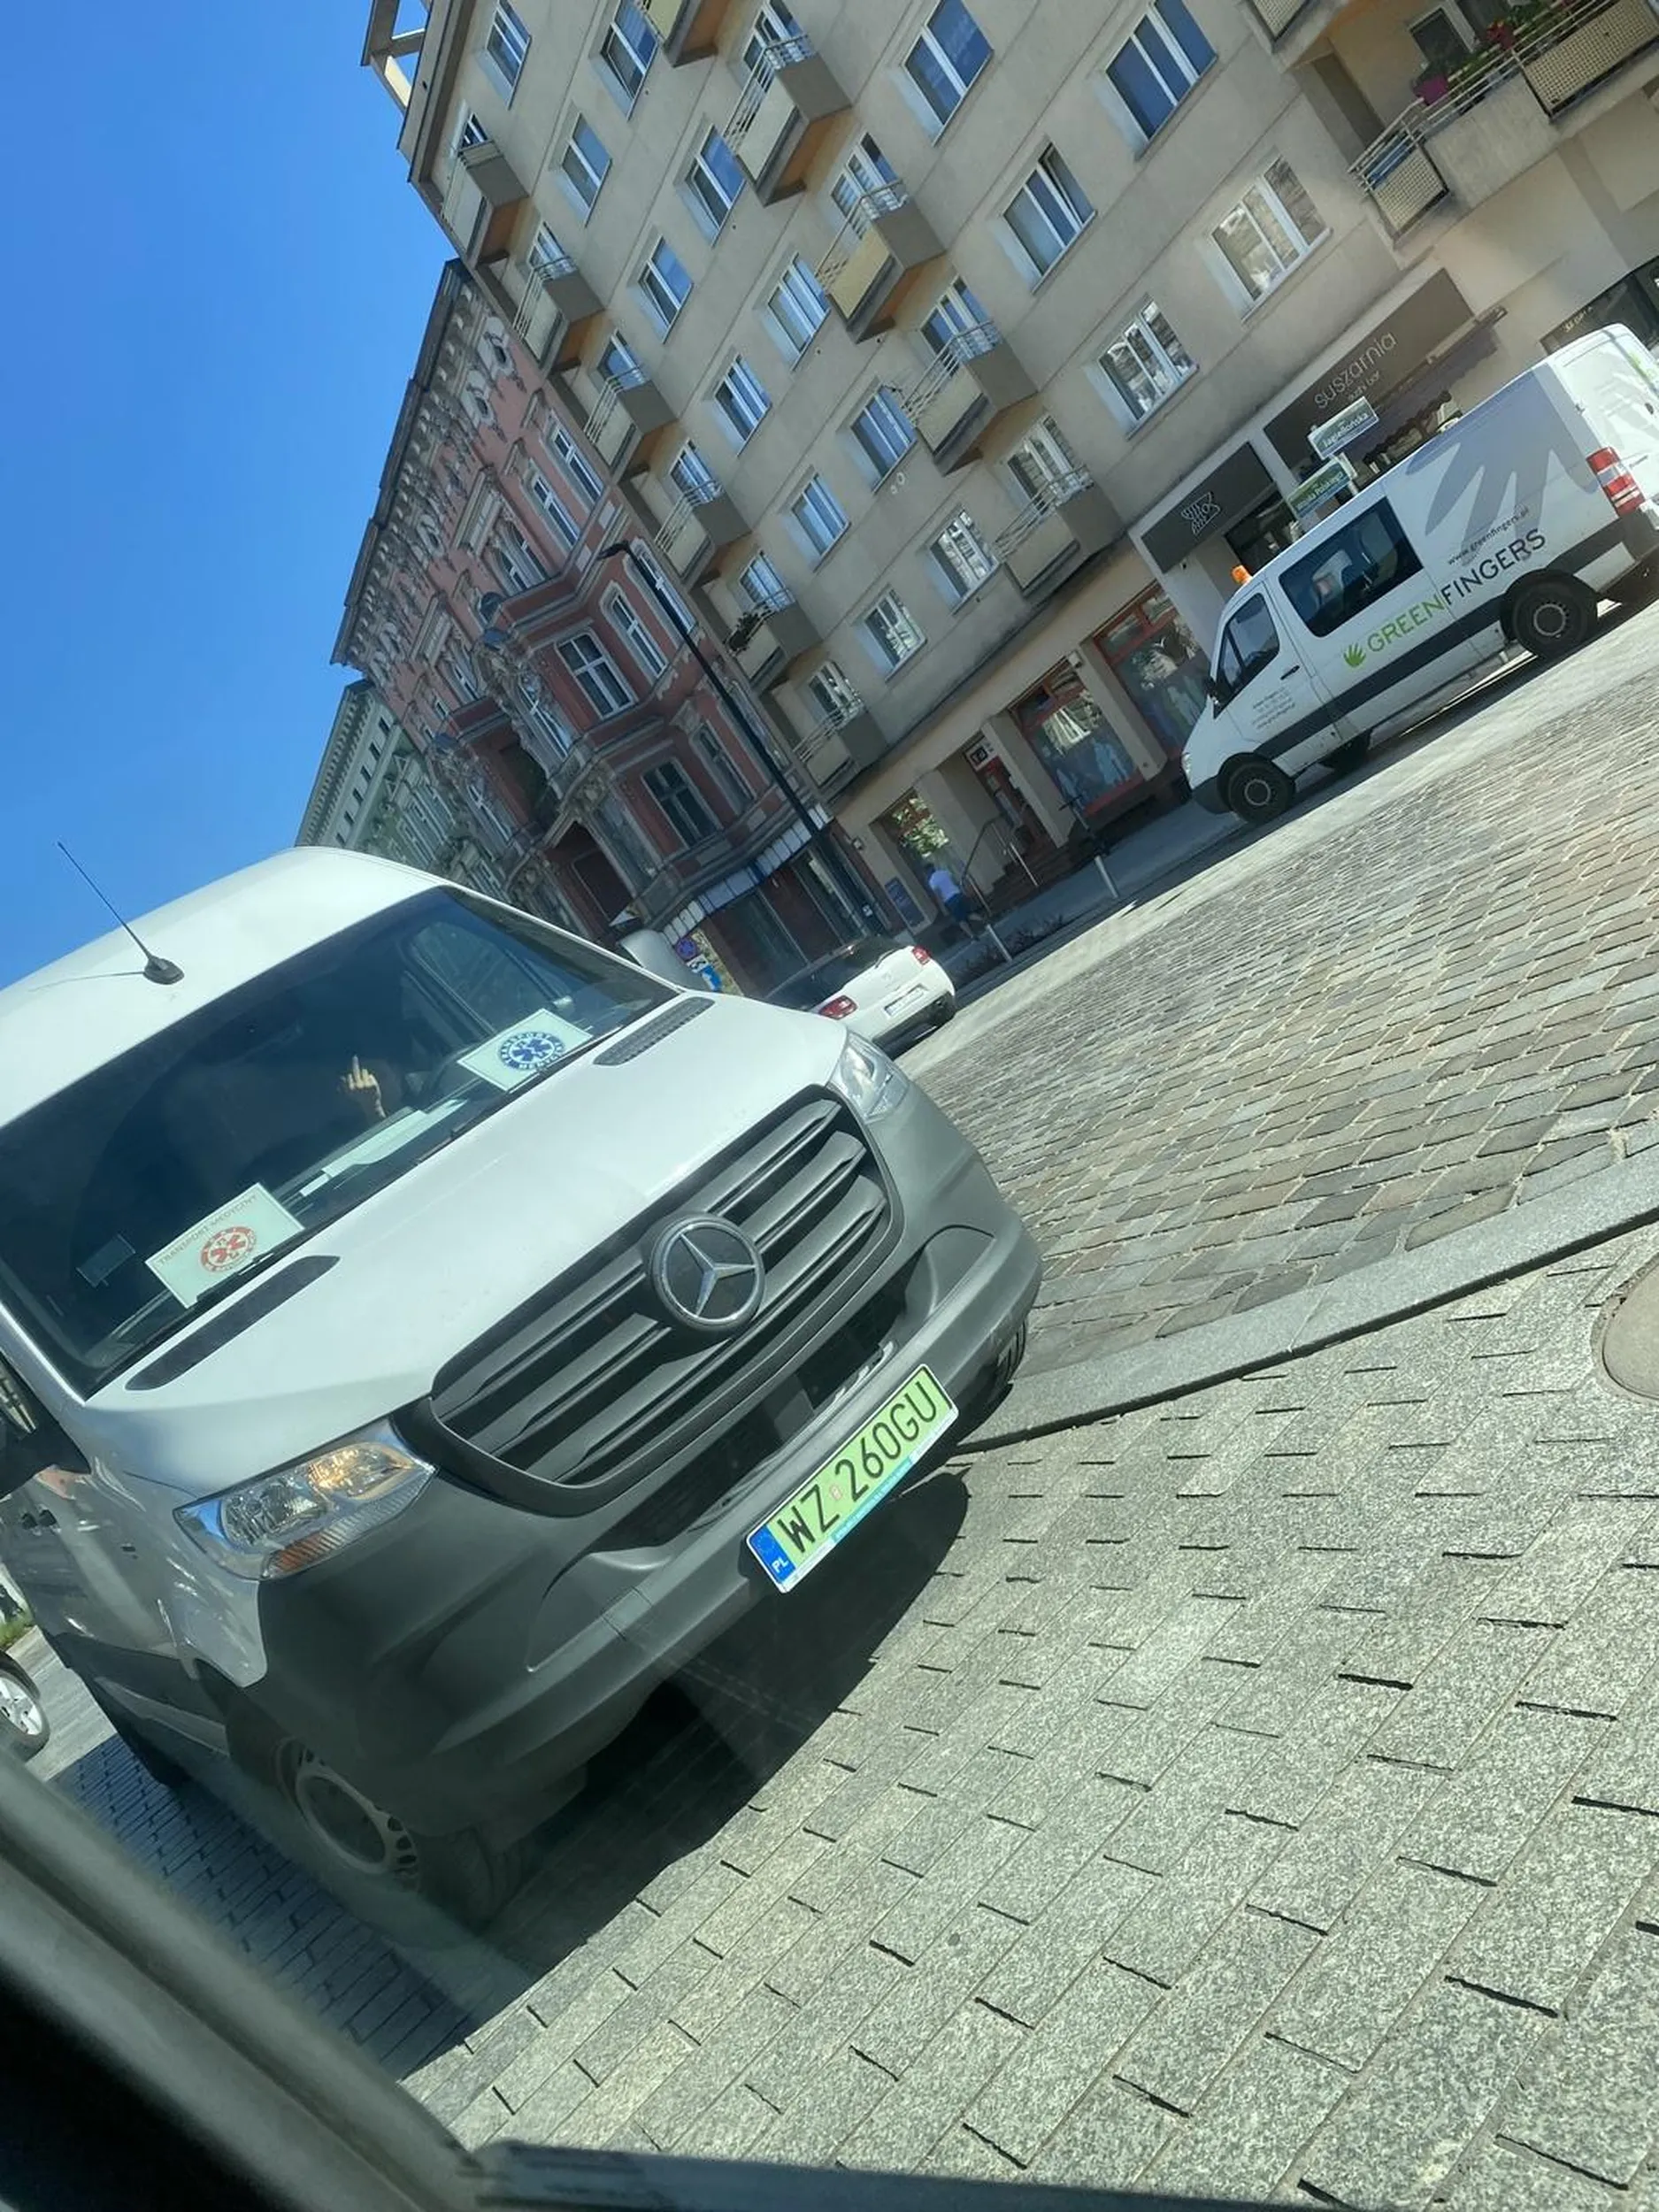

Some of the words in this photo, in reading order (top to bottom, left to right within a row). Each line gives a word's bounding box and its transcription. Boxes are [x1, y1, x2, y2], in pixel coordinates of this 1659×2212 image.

[1314, 332, 1397, 409] suszarnia
[776, 1483, 841, 1554] WZ
[834, 1381, 938, 1502] 260GU
[772, 1556, 789, 1574] PL
